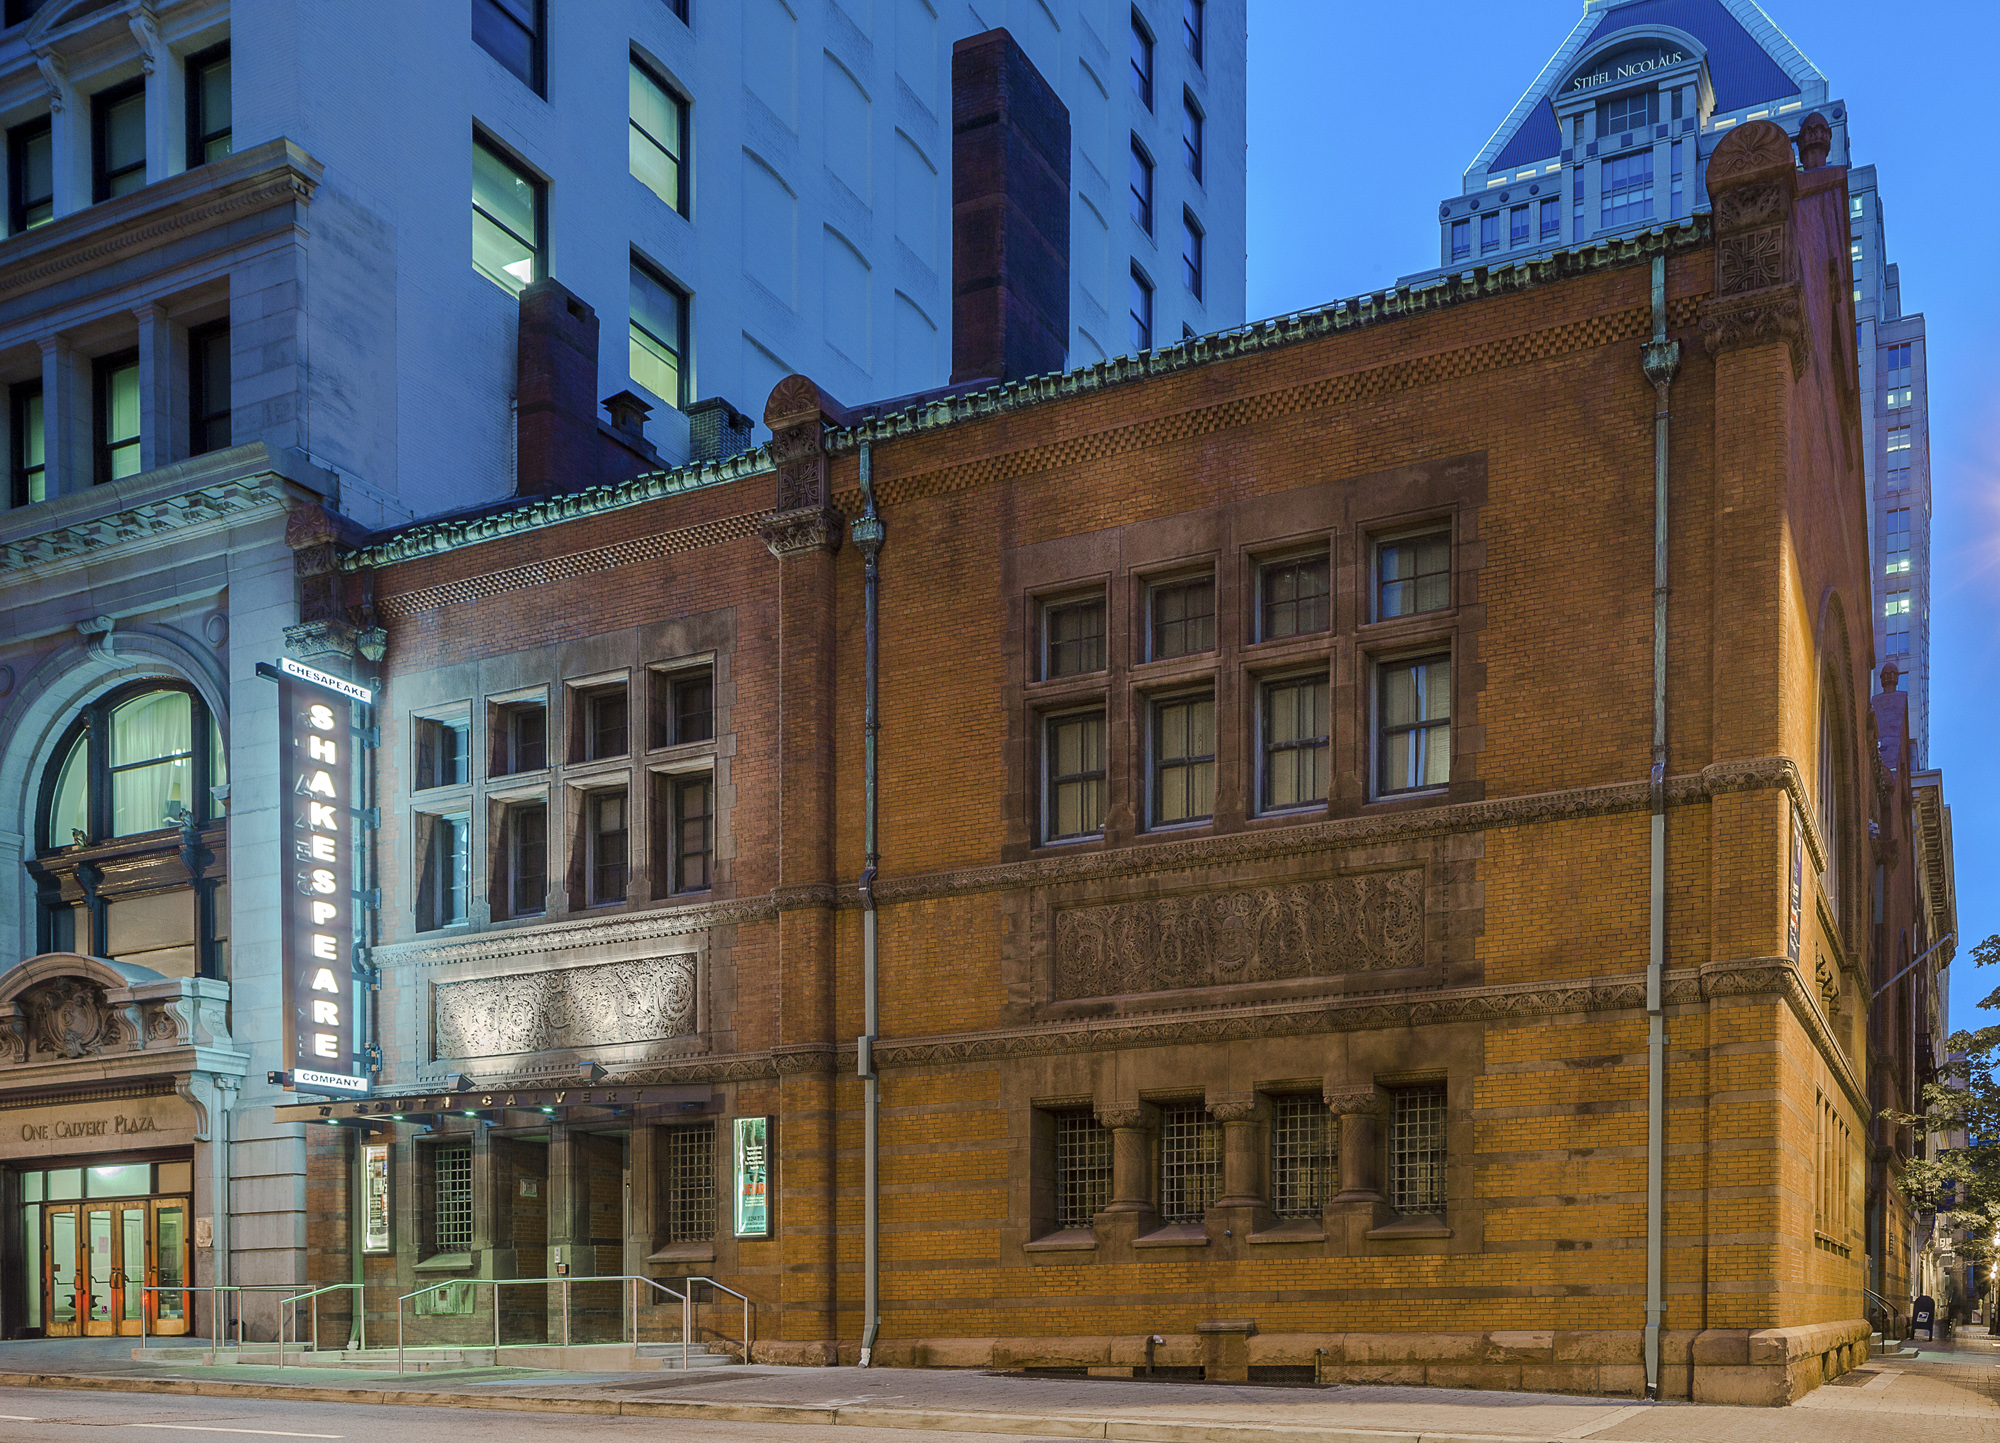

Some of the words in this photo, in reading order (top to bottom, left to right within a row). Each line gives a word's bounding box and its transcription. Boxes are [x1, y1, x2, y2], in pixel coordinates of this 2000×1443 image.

[1573, 71, 1611, 92] STIFEL
[1617, 51, 1682, 80] NICOLAUS
[288, 663, 367, 699] CHESAPEAKE
[308, 703, 339, 1060] SHAKESPEARE
[302, 1072, 359, 1087] COMPANY
[481, 1089, 643, 1107] CALVERT
[21, 1123, 48, 1142] ONE
[54, 1119, 108, 1138] CALVERT
[113, 1114, 156, 1135] PLAZA
